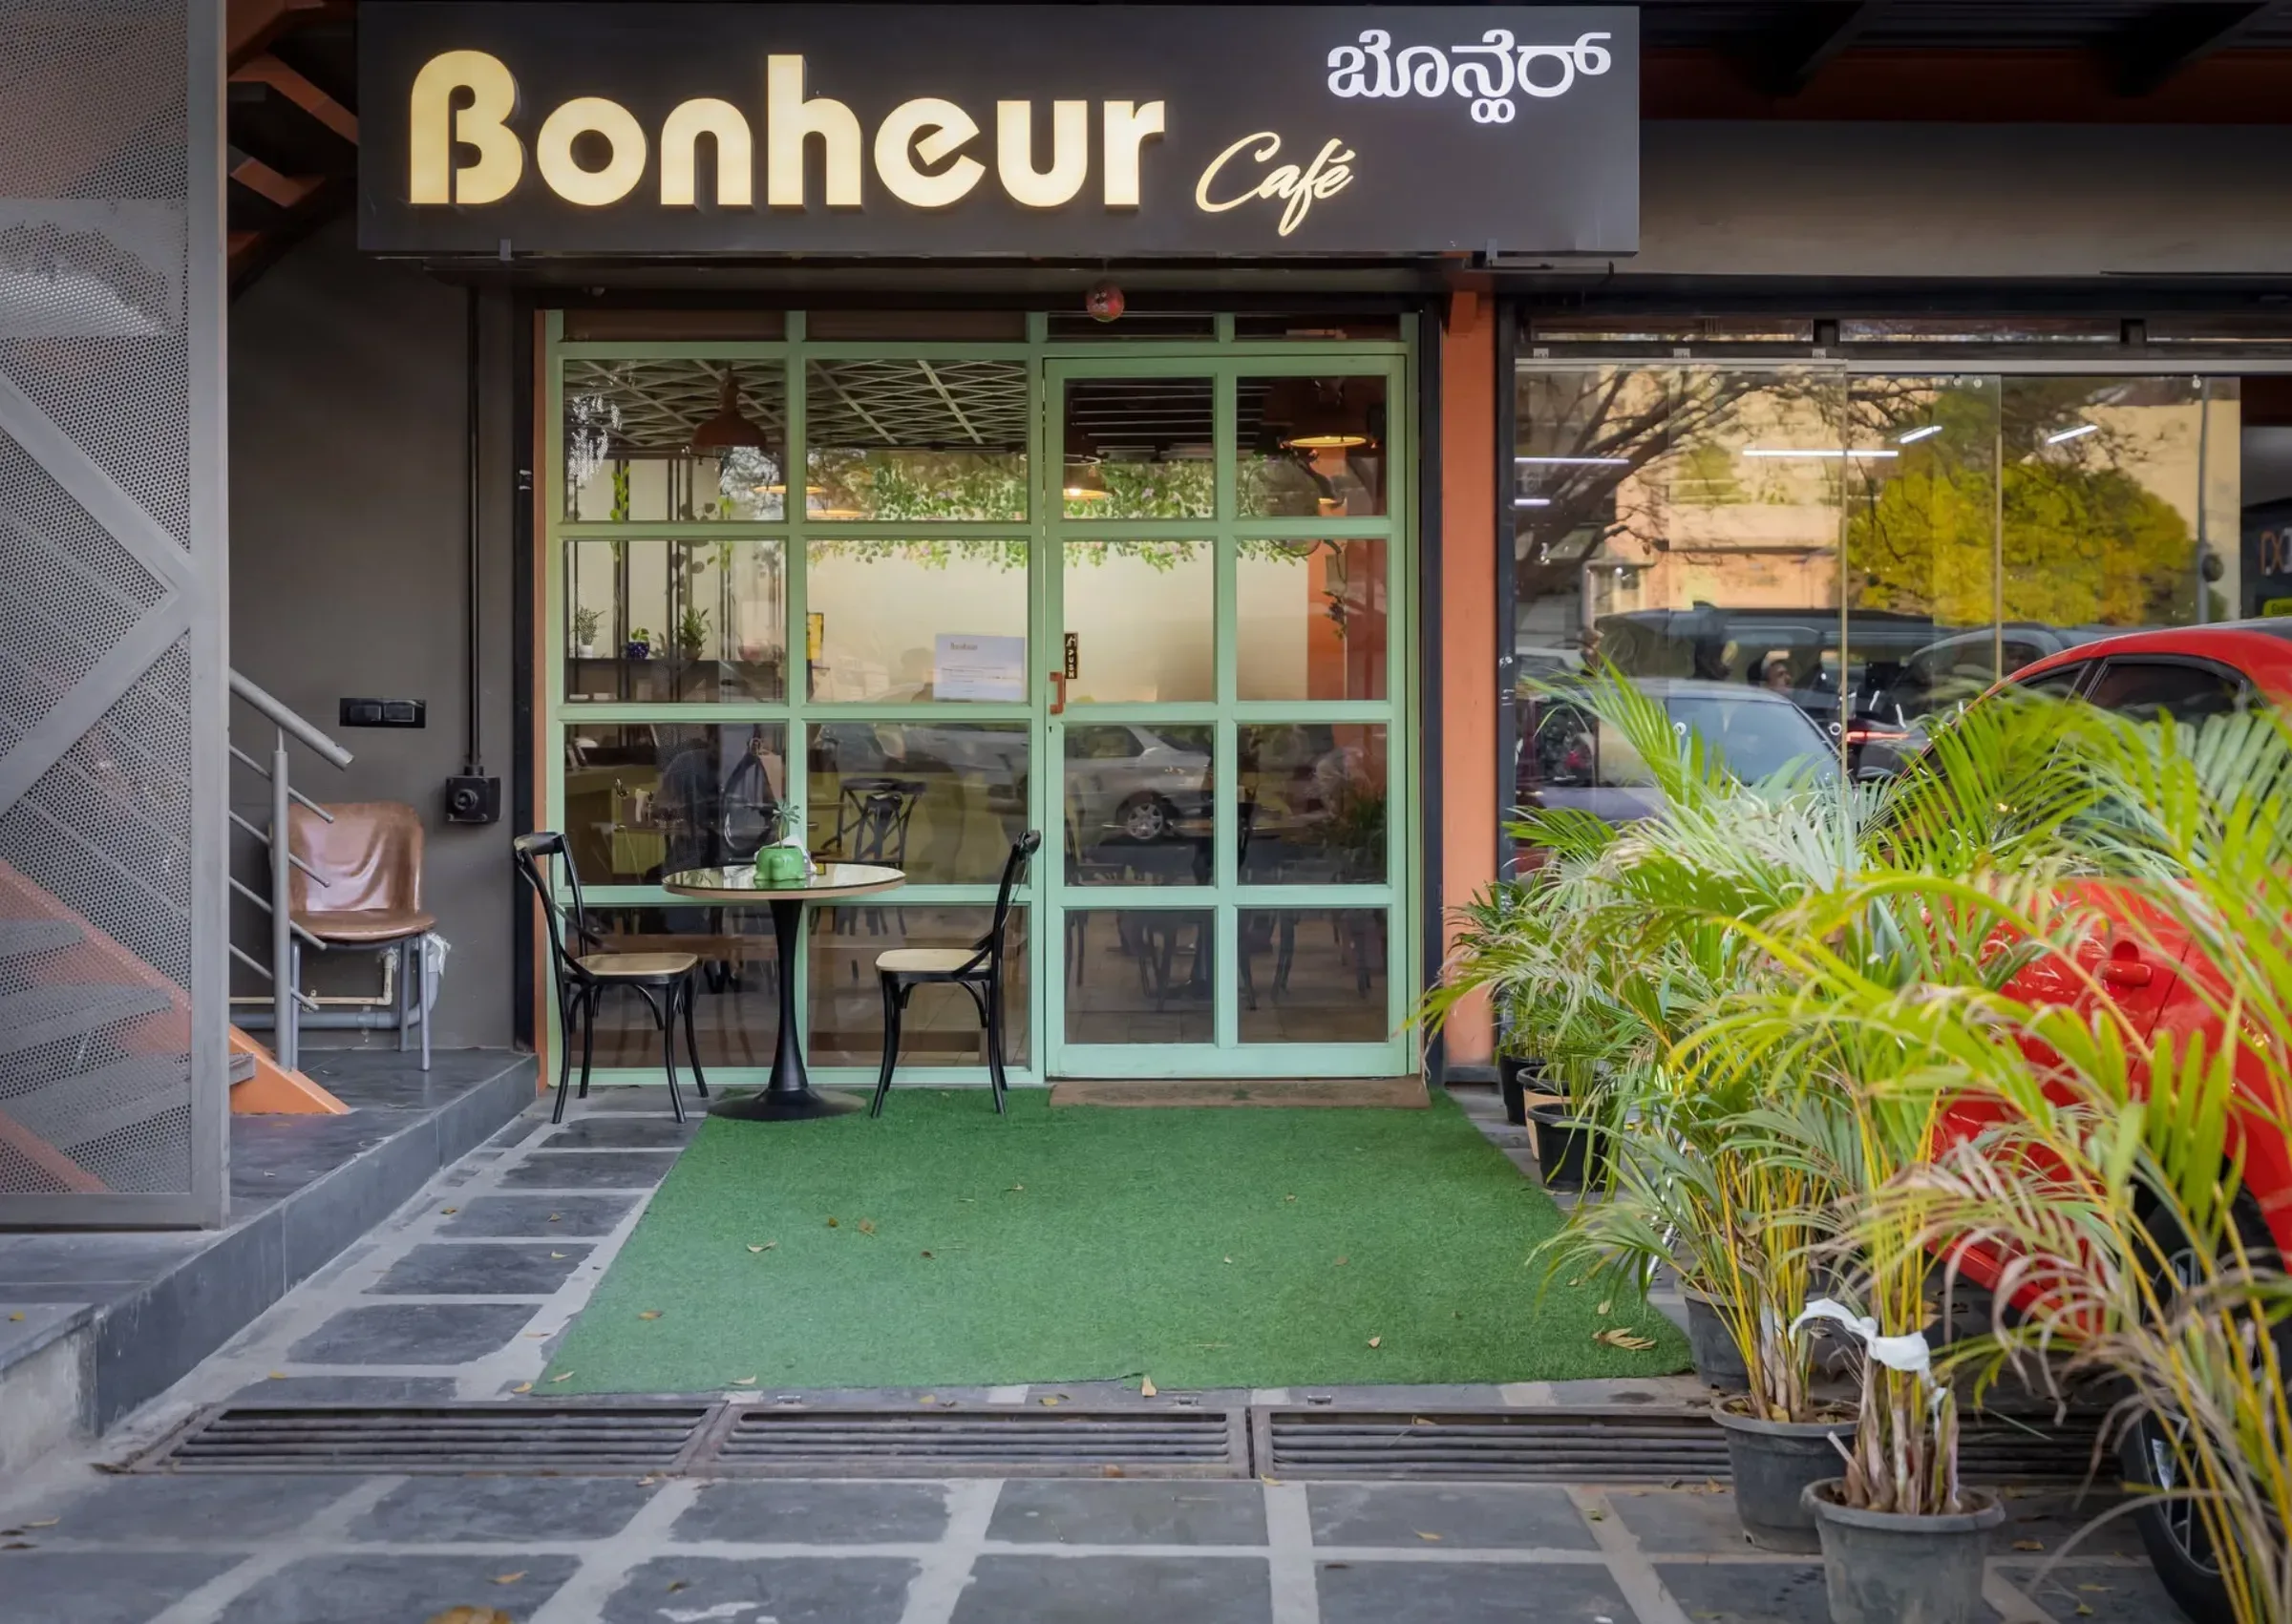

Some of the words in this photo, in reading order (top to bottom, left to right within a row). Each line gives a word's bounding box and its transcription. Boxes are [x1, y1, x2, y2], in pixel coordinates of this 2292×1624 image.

[411, 50, 1166, 209] Bonheur
[1195, 131, 1357, 237] Café
[1067, 649, 1075, 678] PUSH
